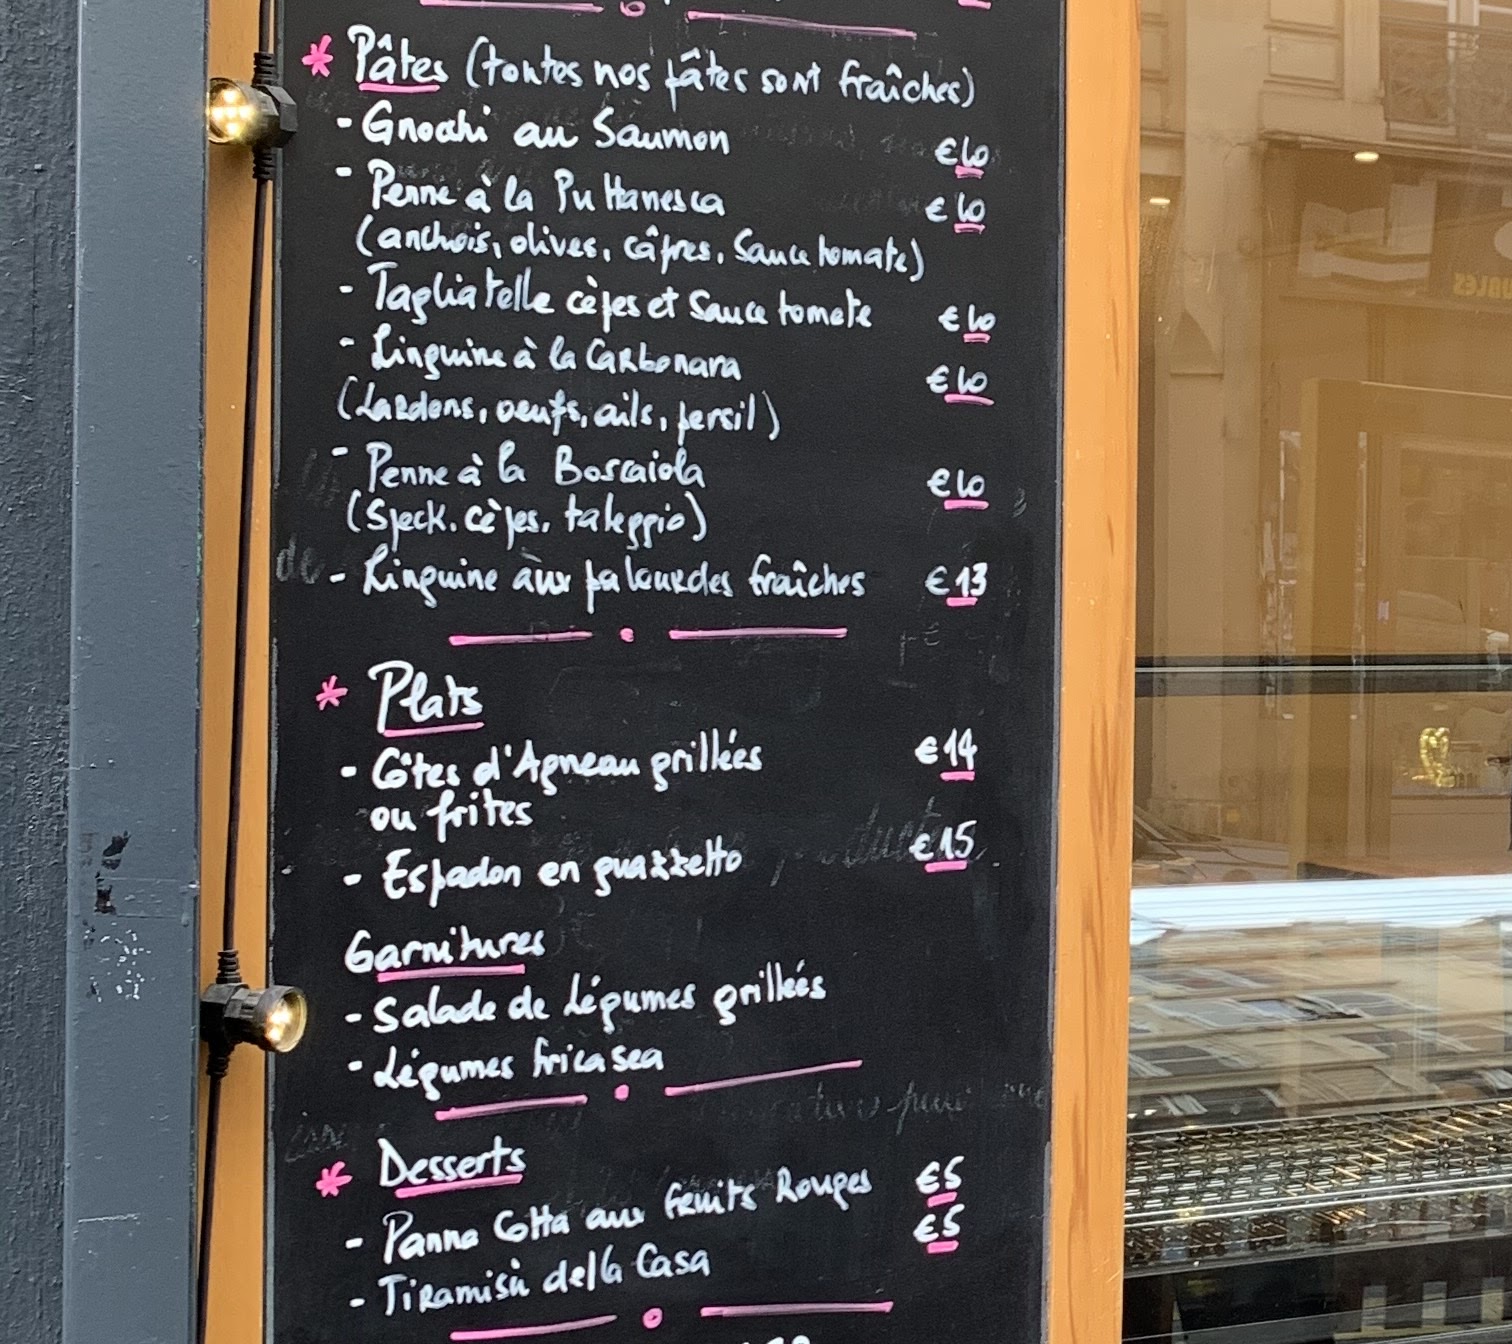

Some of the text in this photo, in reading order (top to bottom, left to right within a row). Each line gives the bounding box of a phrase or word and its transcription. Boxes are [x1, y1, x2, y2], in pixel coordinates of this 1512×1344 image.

[346, 24, 449, 90] Pâtes
[593, 60, 651, 92] nos
[664, 47, 749, 112] pâtes
[761, 61, 821, 95] sont
[513, 121, 579, 150] au
[592, 106, 730, 155] Saumon
[367, 158, 457, 211] Penne
[464, 173, 492, 214] à
[503, 174, 534, 212] la
[565, 274, 641, 334] cèpes
[647, 285, 680, 319] et
[371, 322, 508, 381] Linguine
[513, 336, 538, 370] à
[548, 335, 577, 371] la
[585, 337, 742, 381] Carbonara
[366, 441, 449, 493] Penne
[457, 452, 484, 487] à
[498, 439, 526, 483] la
[363, 543, 498, 608] Linguine
[748, 553, 865, 598] fraîches
[925, 562, 988, 602] €13
[367, 659, 485, 738] Plats
[914, 728, 978, 771] €14
[369, 787, 533, 844] ou frites
[381, 847, 521, 908] Espadon
[537, 860, 581, 887] en
[908, 819, 977, 862] €15
[344, 925, 546, 979] Garnitures
[373, 985, 497, 1034] Salade
[507, 985, 550, 1020] de
[563, 972, 696, 1034] Légumes
[373, 1045, 514, 1102] Légumes
[377, 1135, 526, 1187] Desserts
[382, 1210, 479, 1265] Panna
[493, 1204, 570, 1243] Cotta
[585, 1207, 645, 1230] aux
[775, 1166, 872, 1211] Rouges
[915, 1155, 965, 1201] €5
[542, 1244, 623, 1294] della
[635, 1242, 710, 1279] Casa
[912, 1203, 965, 1250] €5
